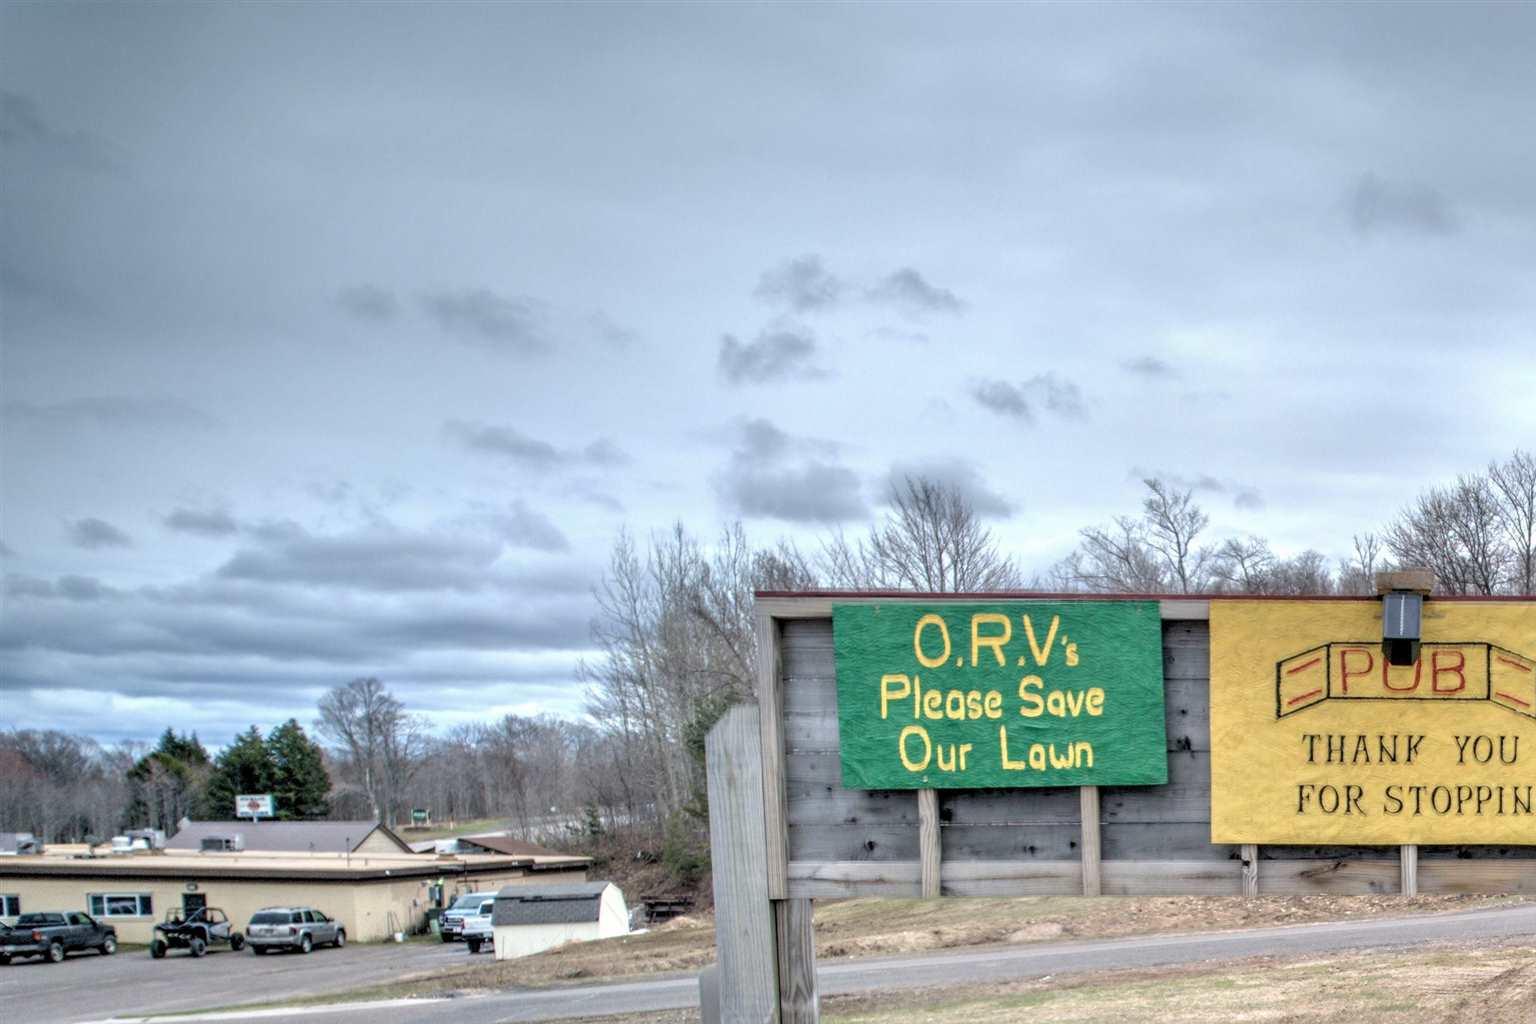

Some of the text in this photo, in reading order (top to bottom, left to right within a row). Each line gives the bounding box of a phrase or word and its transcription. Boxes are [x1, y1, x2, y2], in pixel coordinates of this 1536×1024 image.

[913, 613, 1080, 669] O.R.V's
[1339, 648, 1467, 696] PUB
[880, 673, 1105, 721] Please Save
[899, 724, 1095, 773] Our Lawn
[1301, 733, 1521, 766] THANK YOU
[1296, 784, 1366, 817] FOR
